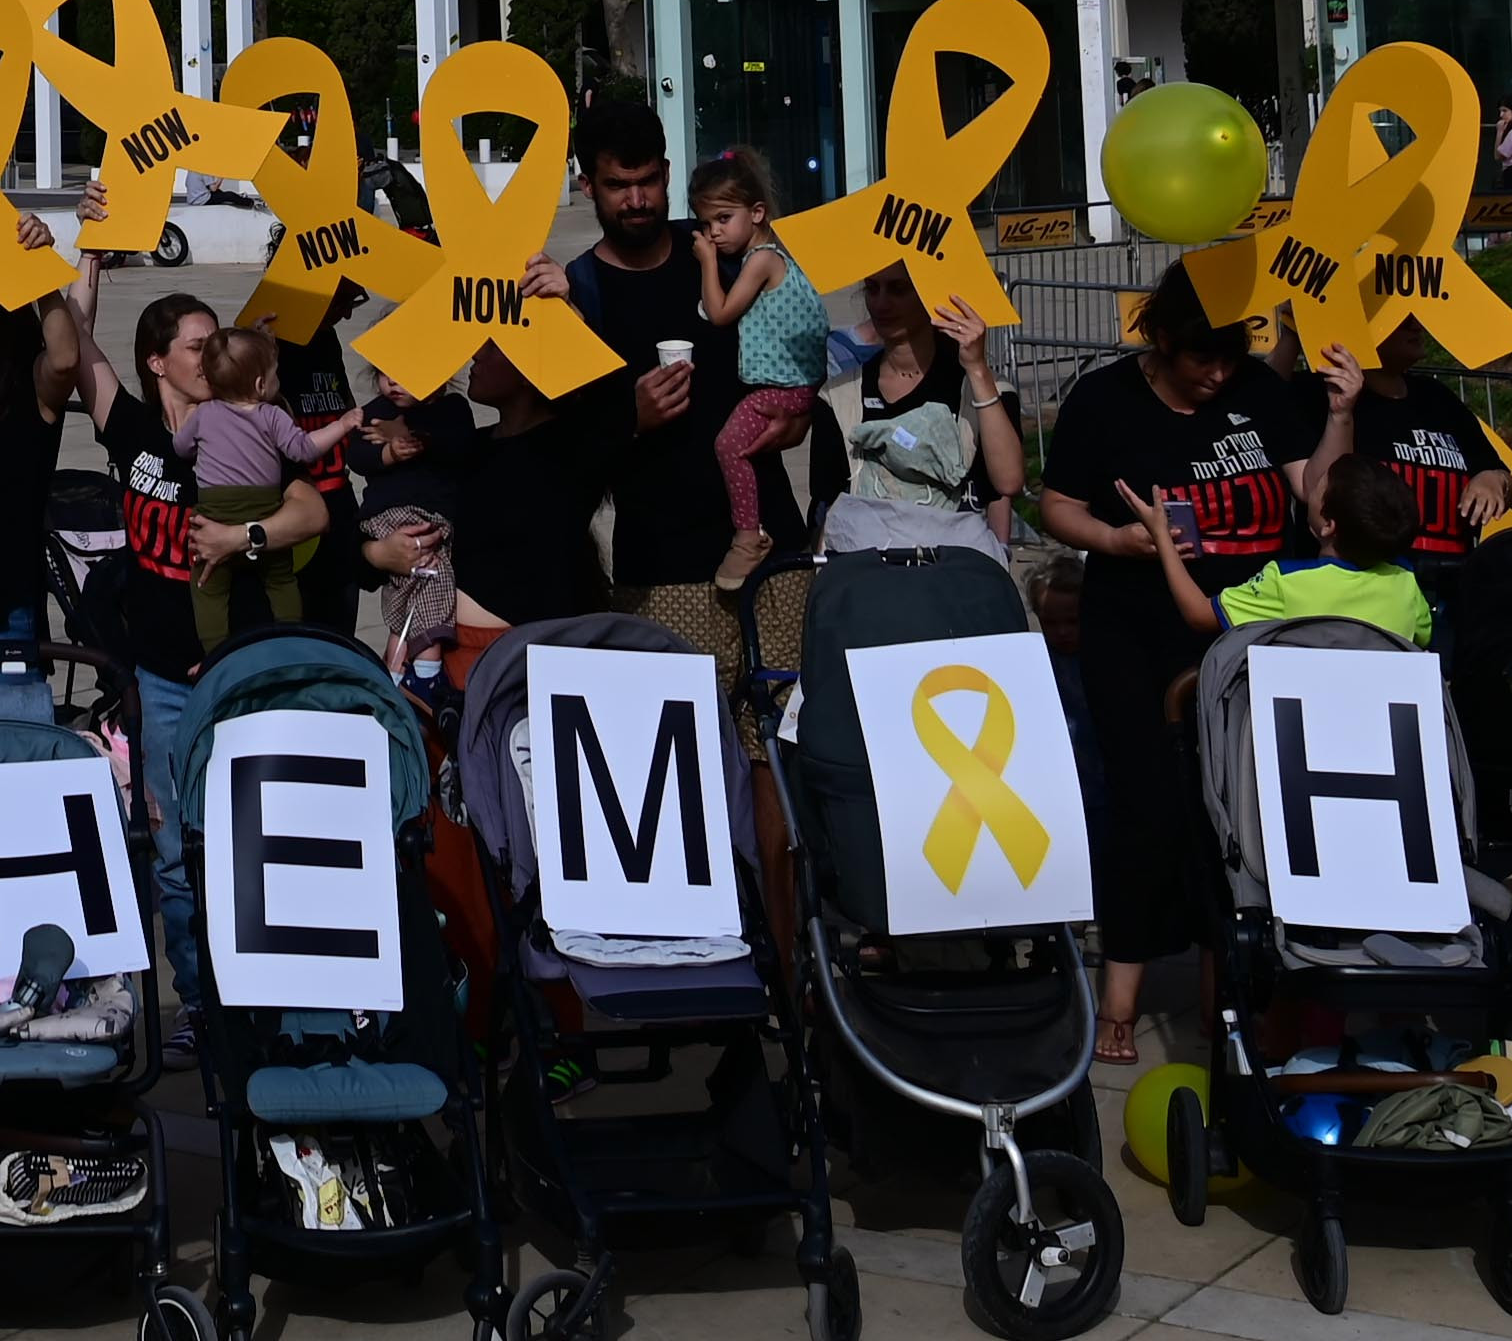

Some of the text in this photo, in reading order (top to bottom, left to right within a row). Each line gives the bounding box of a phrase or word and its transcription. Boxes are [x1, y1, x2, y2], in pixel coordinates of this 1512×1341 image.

[121, 109, 199, 174] NOW.
[297, 218, 368, 271] NOW.
[874, 195, 952, 261] NOW.
[1270, 236, 1340, 304] NOW.
[1375, 254, 1449, 301] NOW.
[453, 276, 530, 327] NOW.
[1190, 454, 1243, 480] הביתה
[1212, 430, 1264, 460] מחזירים
[129, 466, 156, 495] THEM
